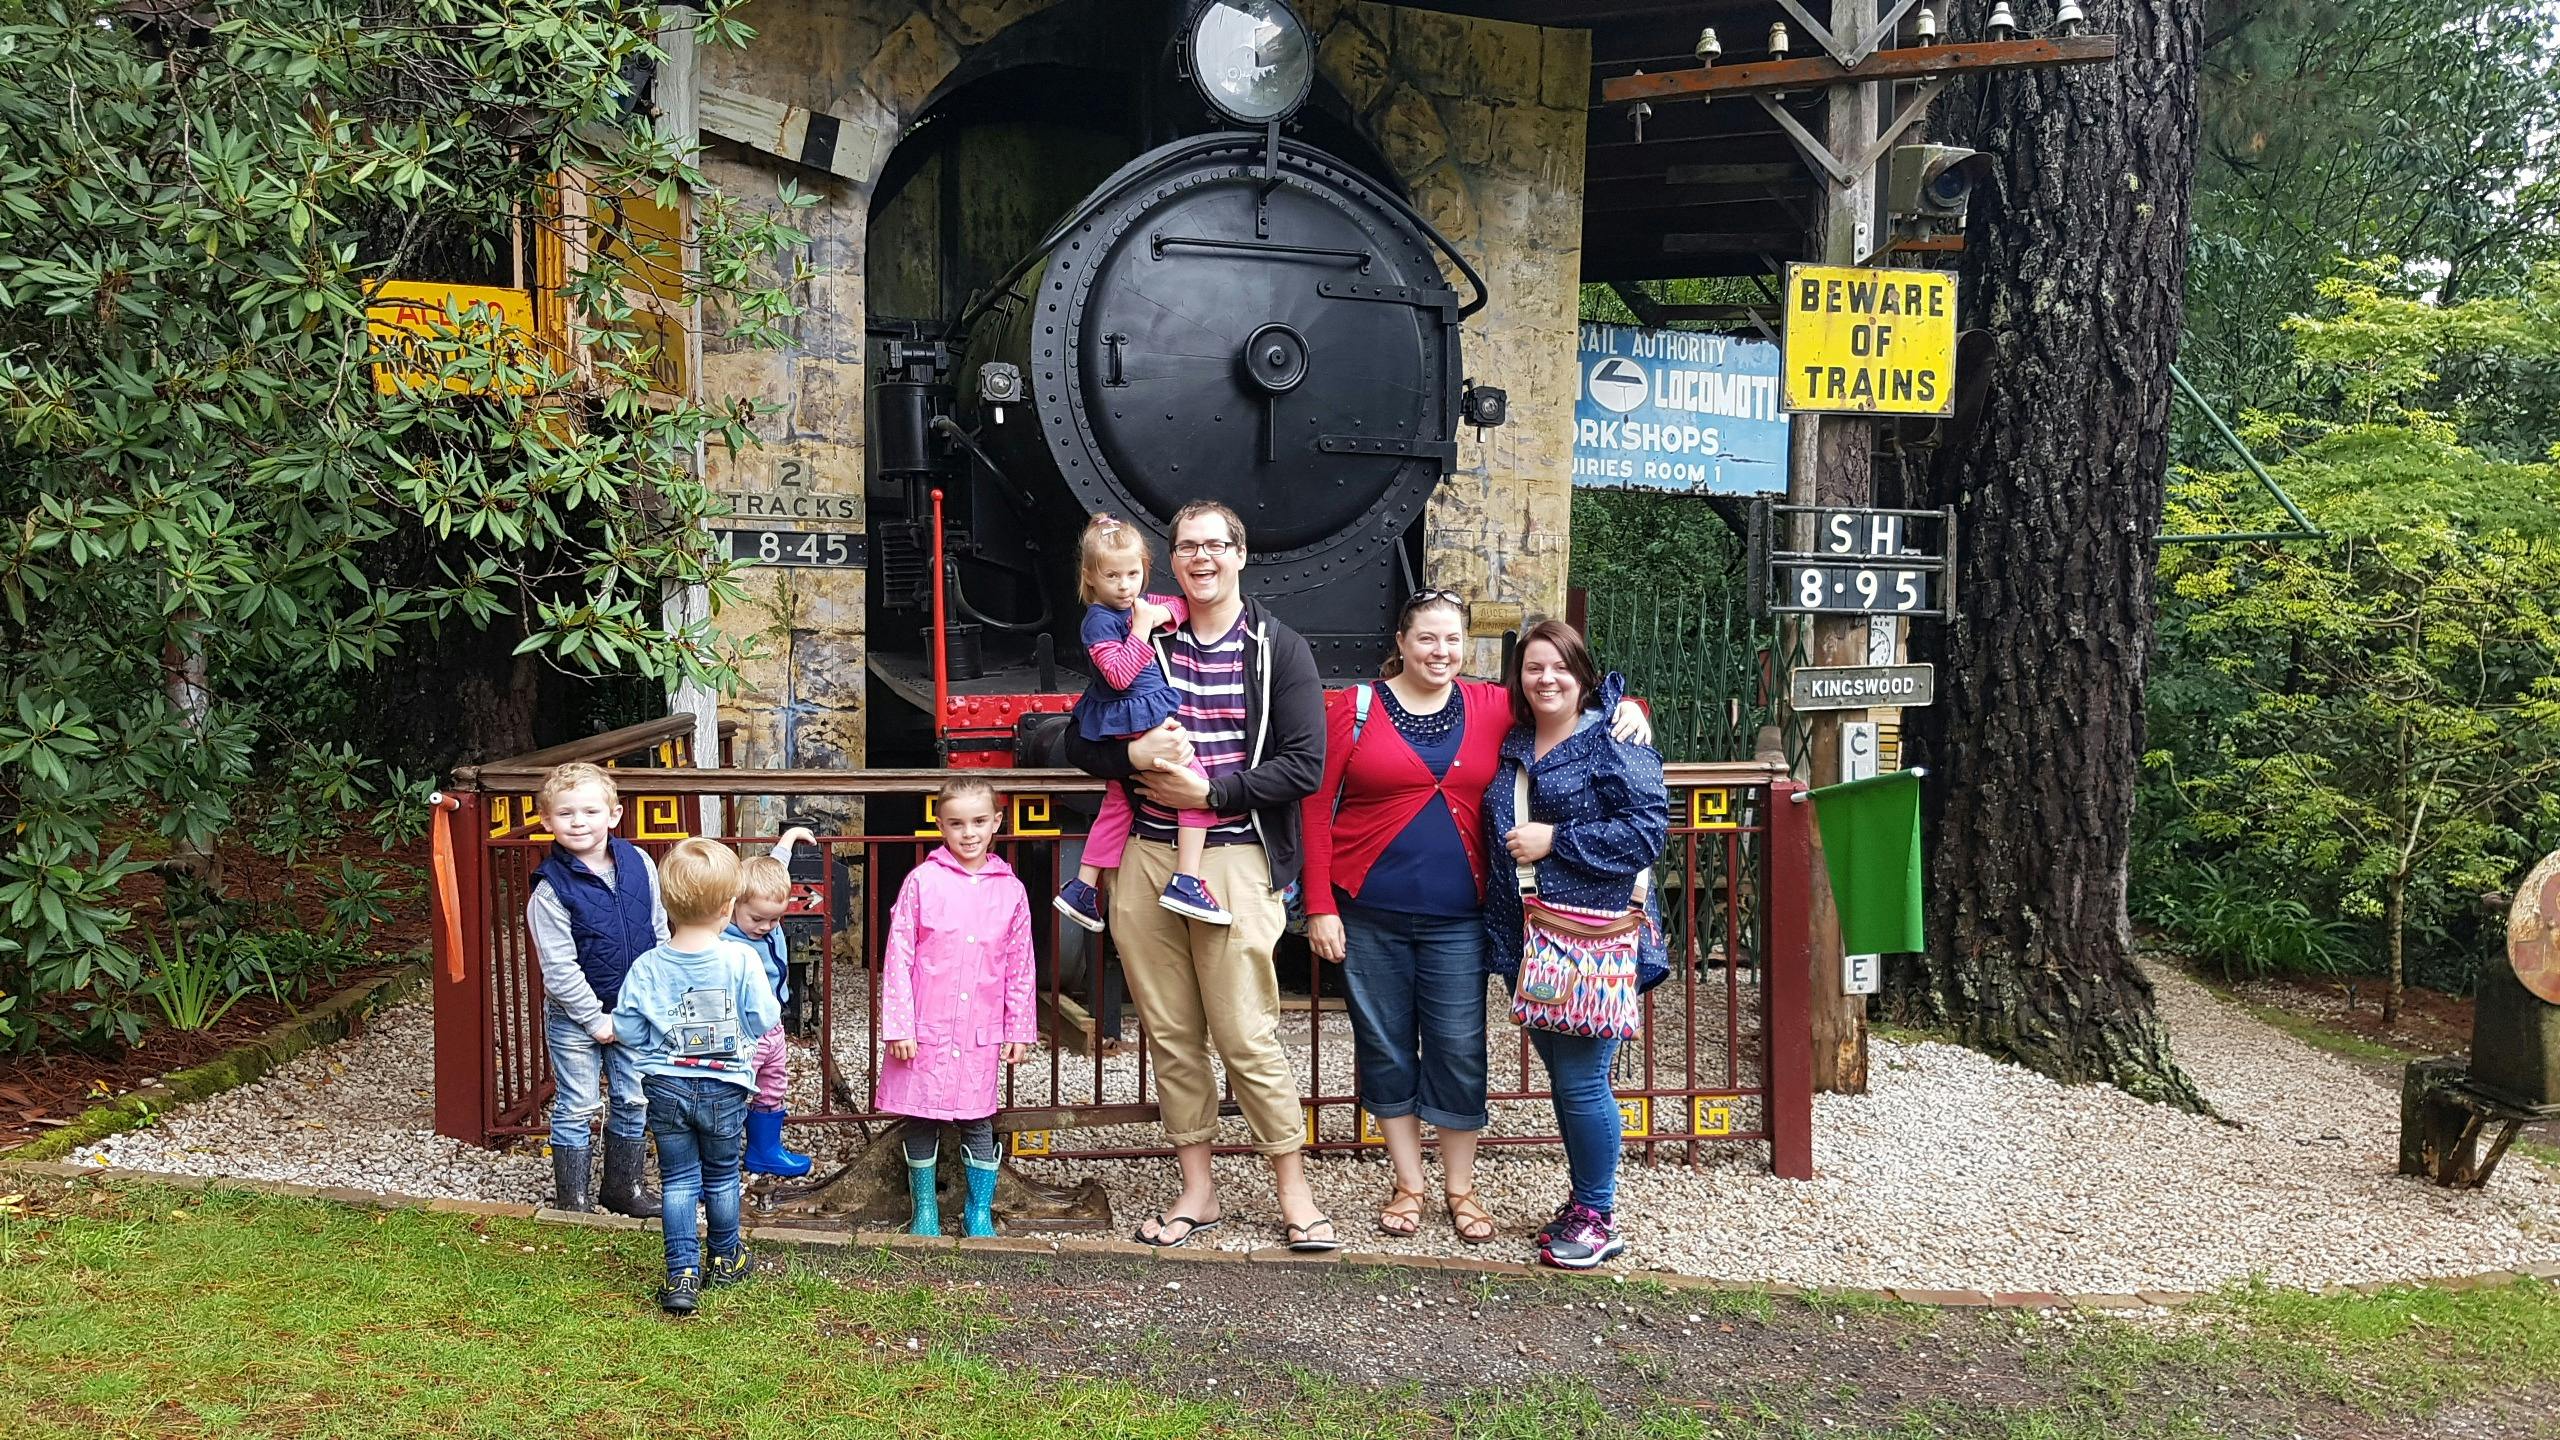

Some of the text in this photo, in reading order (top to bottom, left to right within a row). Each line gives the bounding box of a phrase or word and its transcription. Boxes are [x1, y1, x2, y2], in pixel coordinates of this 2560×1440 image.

[1800, 279, 1944, 317] BEWARE
[1631, 329, 1727, 364] AUTHORITY
[1851, 324, 1892, 357] OF
[1804, 366, 1936, 402] TRAINS
[781, 461, 802, 487] 2
[1644, 461, 1705, 481] ROOM
[1714, 465, 1722, 482] 1
[728, 494, 854, 519] TRACKS
[1811, 677, 1915, 698] KINGSWOOD
